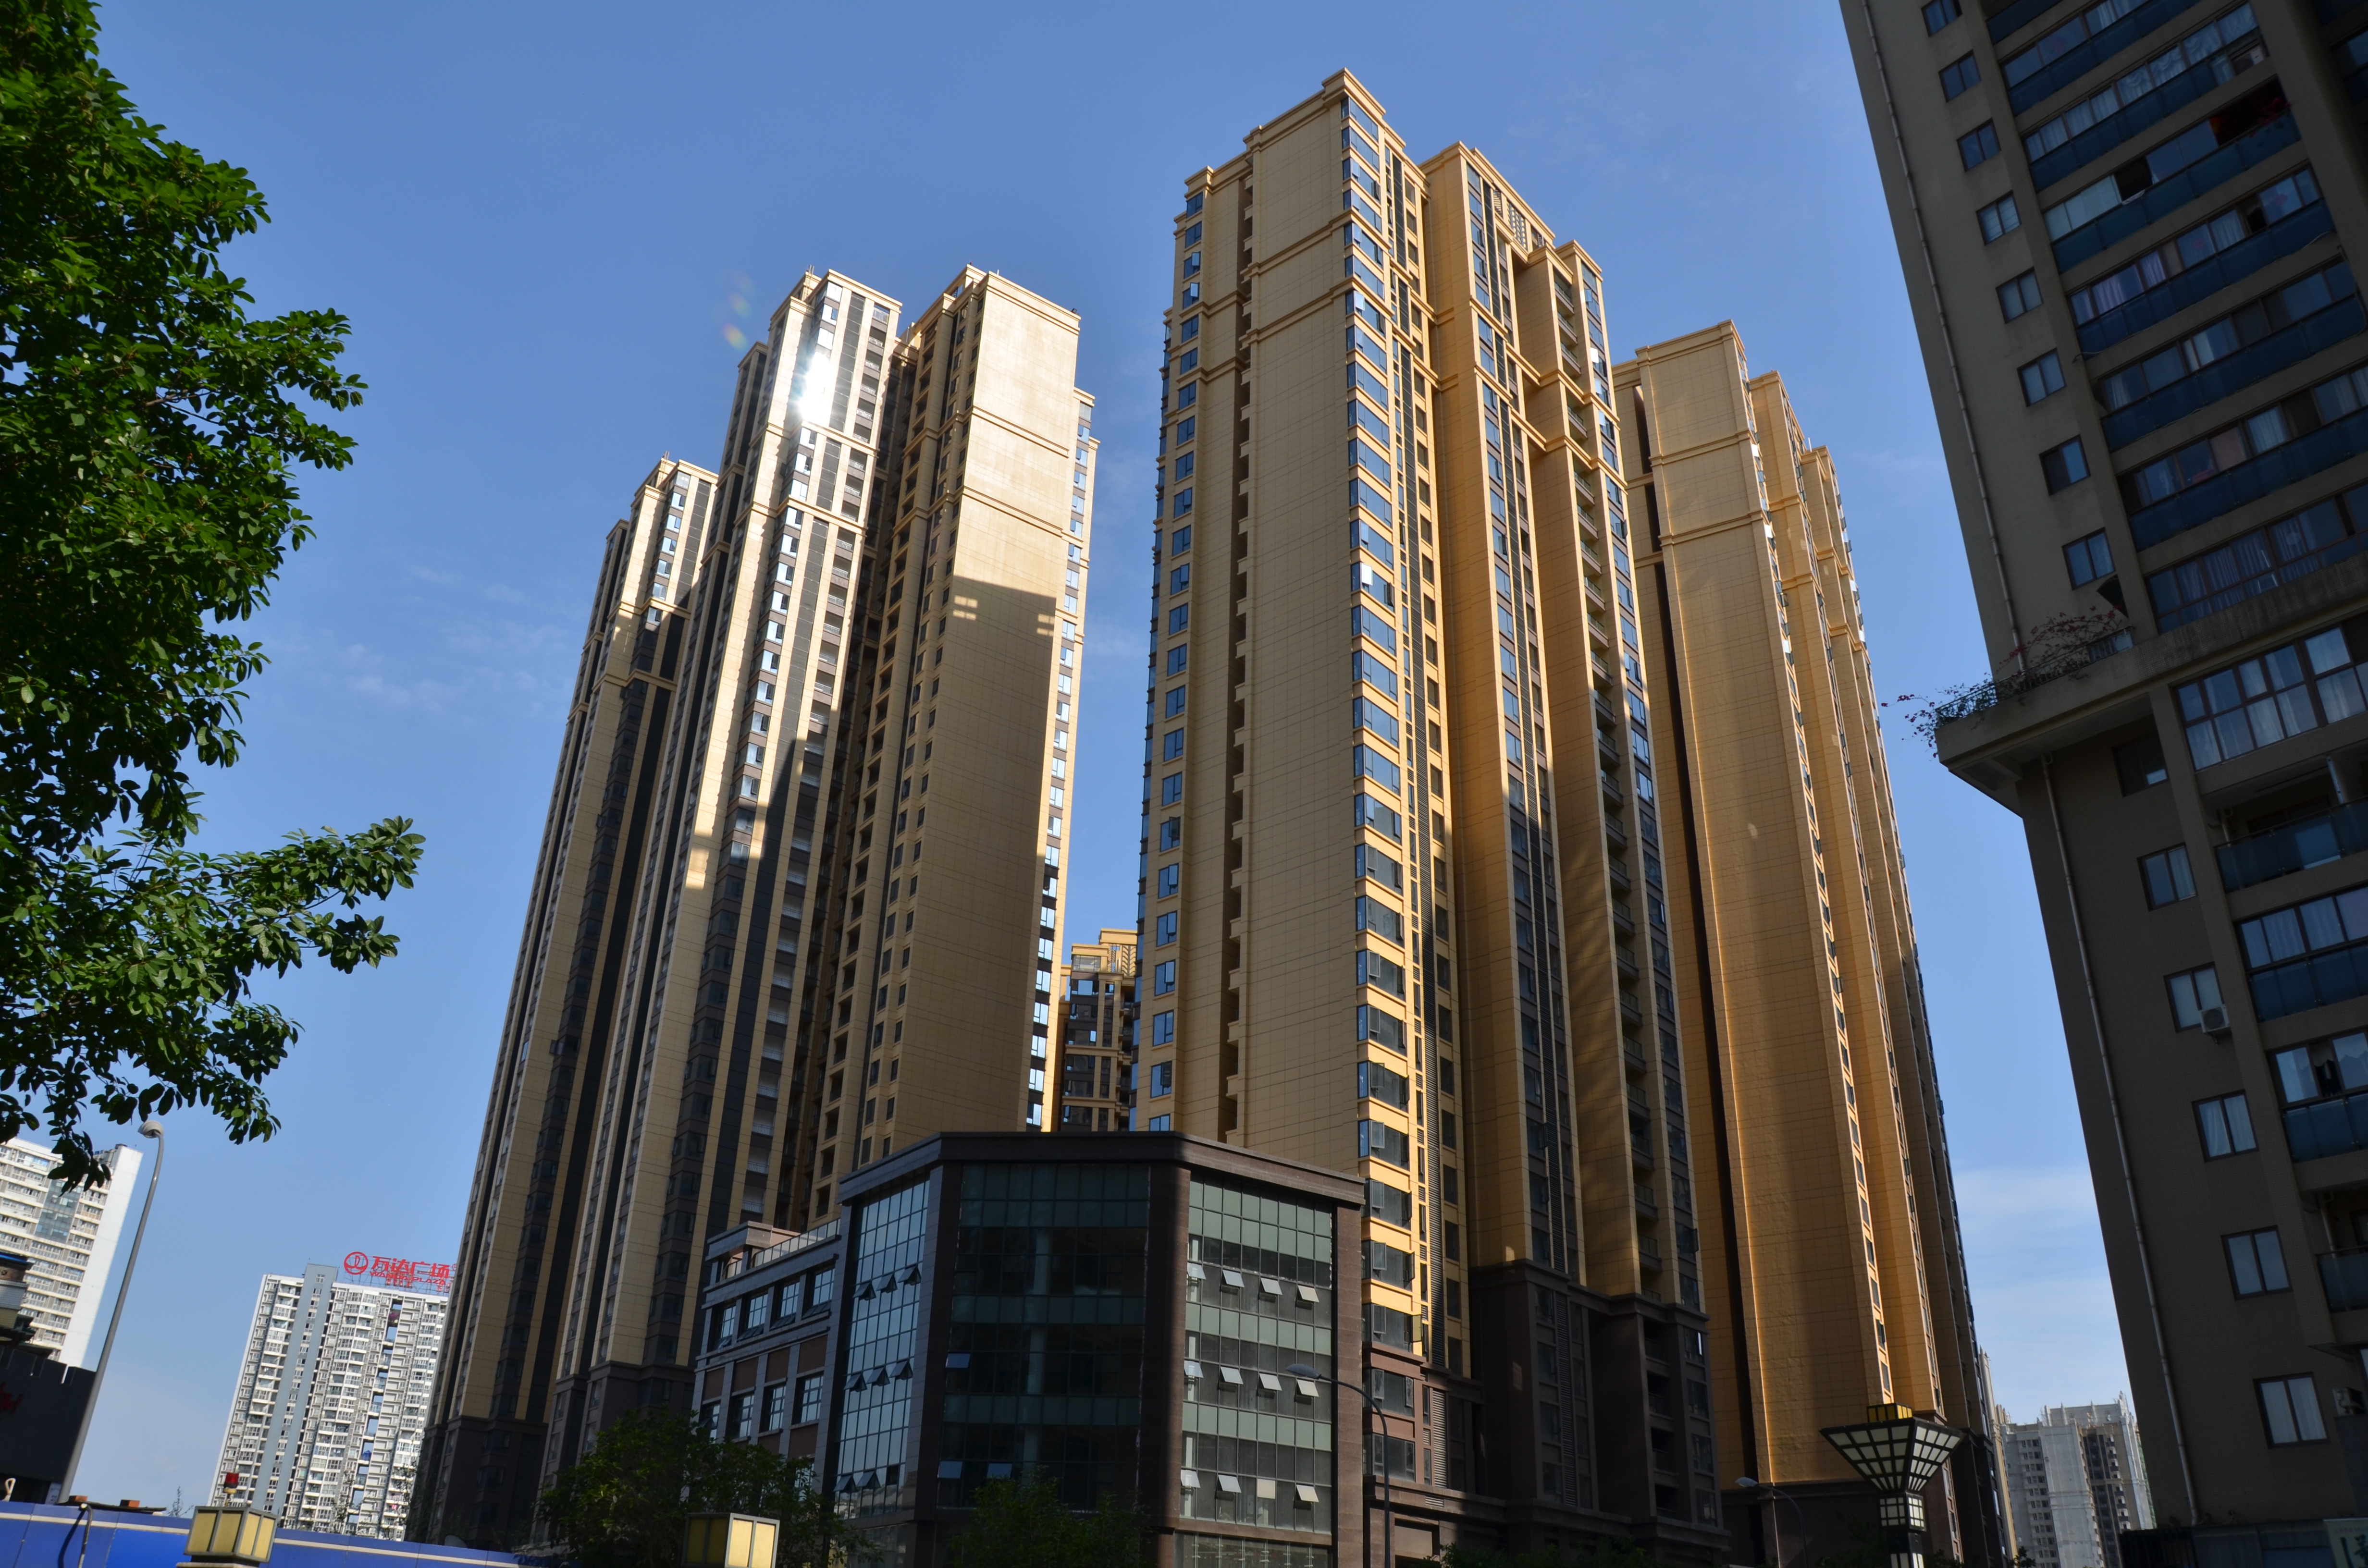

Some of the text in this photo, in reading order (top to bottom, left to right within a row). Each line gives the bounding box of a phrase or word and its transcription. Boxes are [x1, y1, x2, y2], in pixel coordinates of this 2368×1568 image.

[371, 1256, 450, 1278] 万达广场
[369, 1271, 408, 1281] WANDA
[412, 1277, 446, 1285] PLAZA
